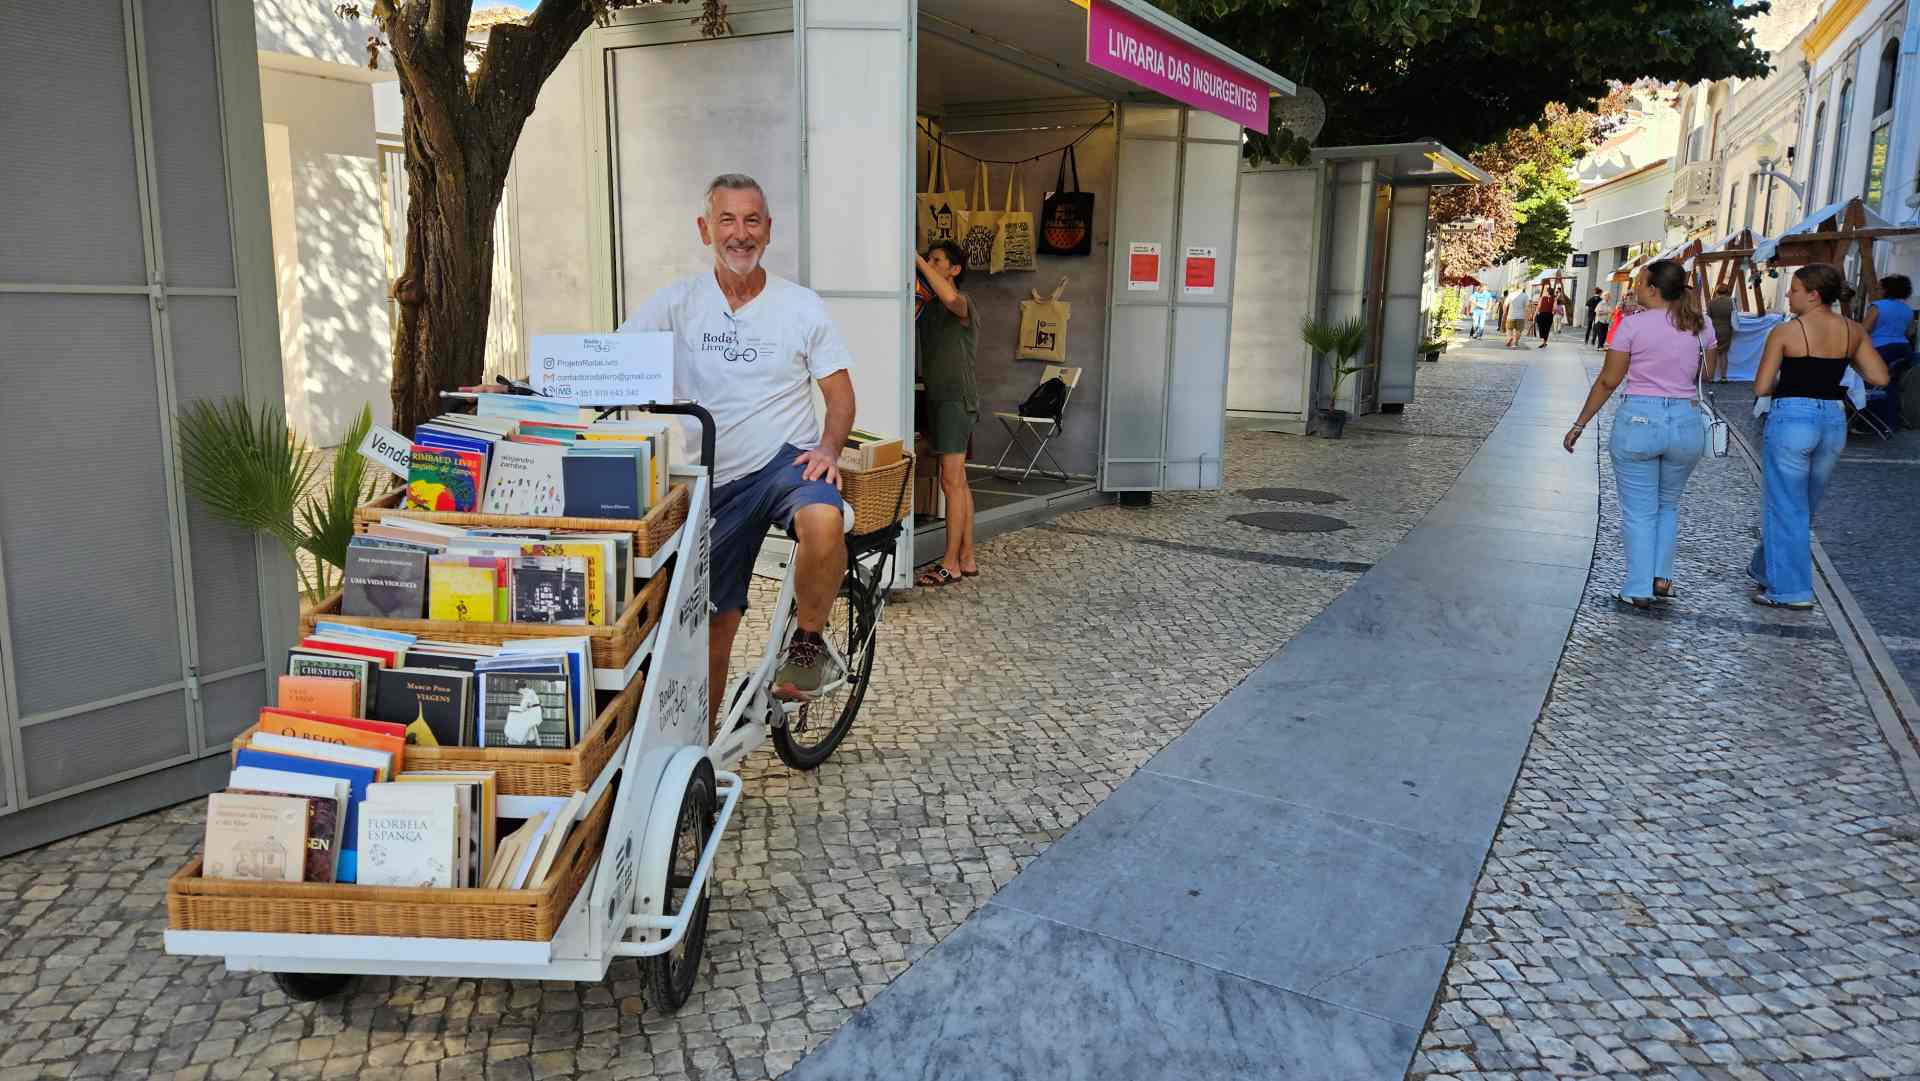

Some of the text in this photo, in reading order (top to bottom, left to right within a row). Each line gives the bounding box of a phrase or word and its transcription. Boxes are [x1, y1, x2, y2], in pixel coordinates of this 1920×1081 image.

[1107, 28, 1258, 113] LIVRARIA DAS INSURGENTES
[703, 332, 734, 344] Roda
[411, 452, 452, 463] RIMBAUD
[367, 577, 385, 587] VIDA
[301, 665, 356, 679] CHESTERTON
[367, 816, 429, 831] FLORBELA
